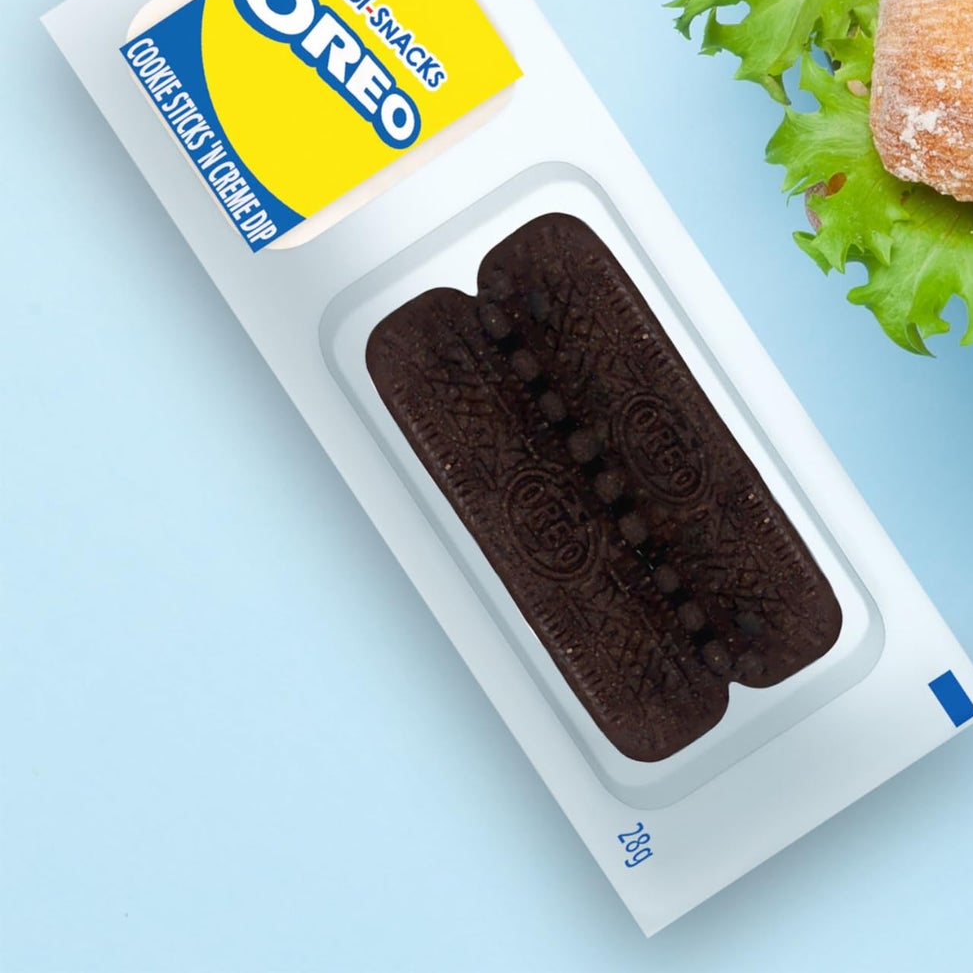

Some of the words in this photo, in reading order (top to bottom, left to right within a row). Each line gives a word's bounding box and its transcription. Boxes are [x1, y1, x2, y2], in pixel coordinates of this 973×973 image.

[126, 37, 183, 103] COOKIE
[161, 91, 215, 151] STICKS
[197, 139, 228, 171] 'N
[207, 160, 262, 222] CREME
[240, 209, 278, 244] DIP
[617, 821, 654, 868] 28g
